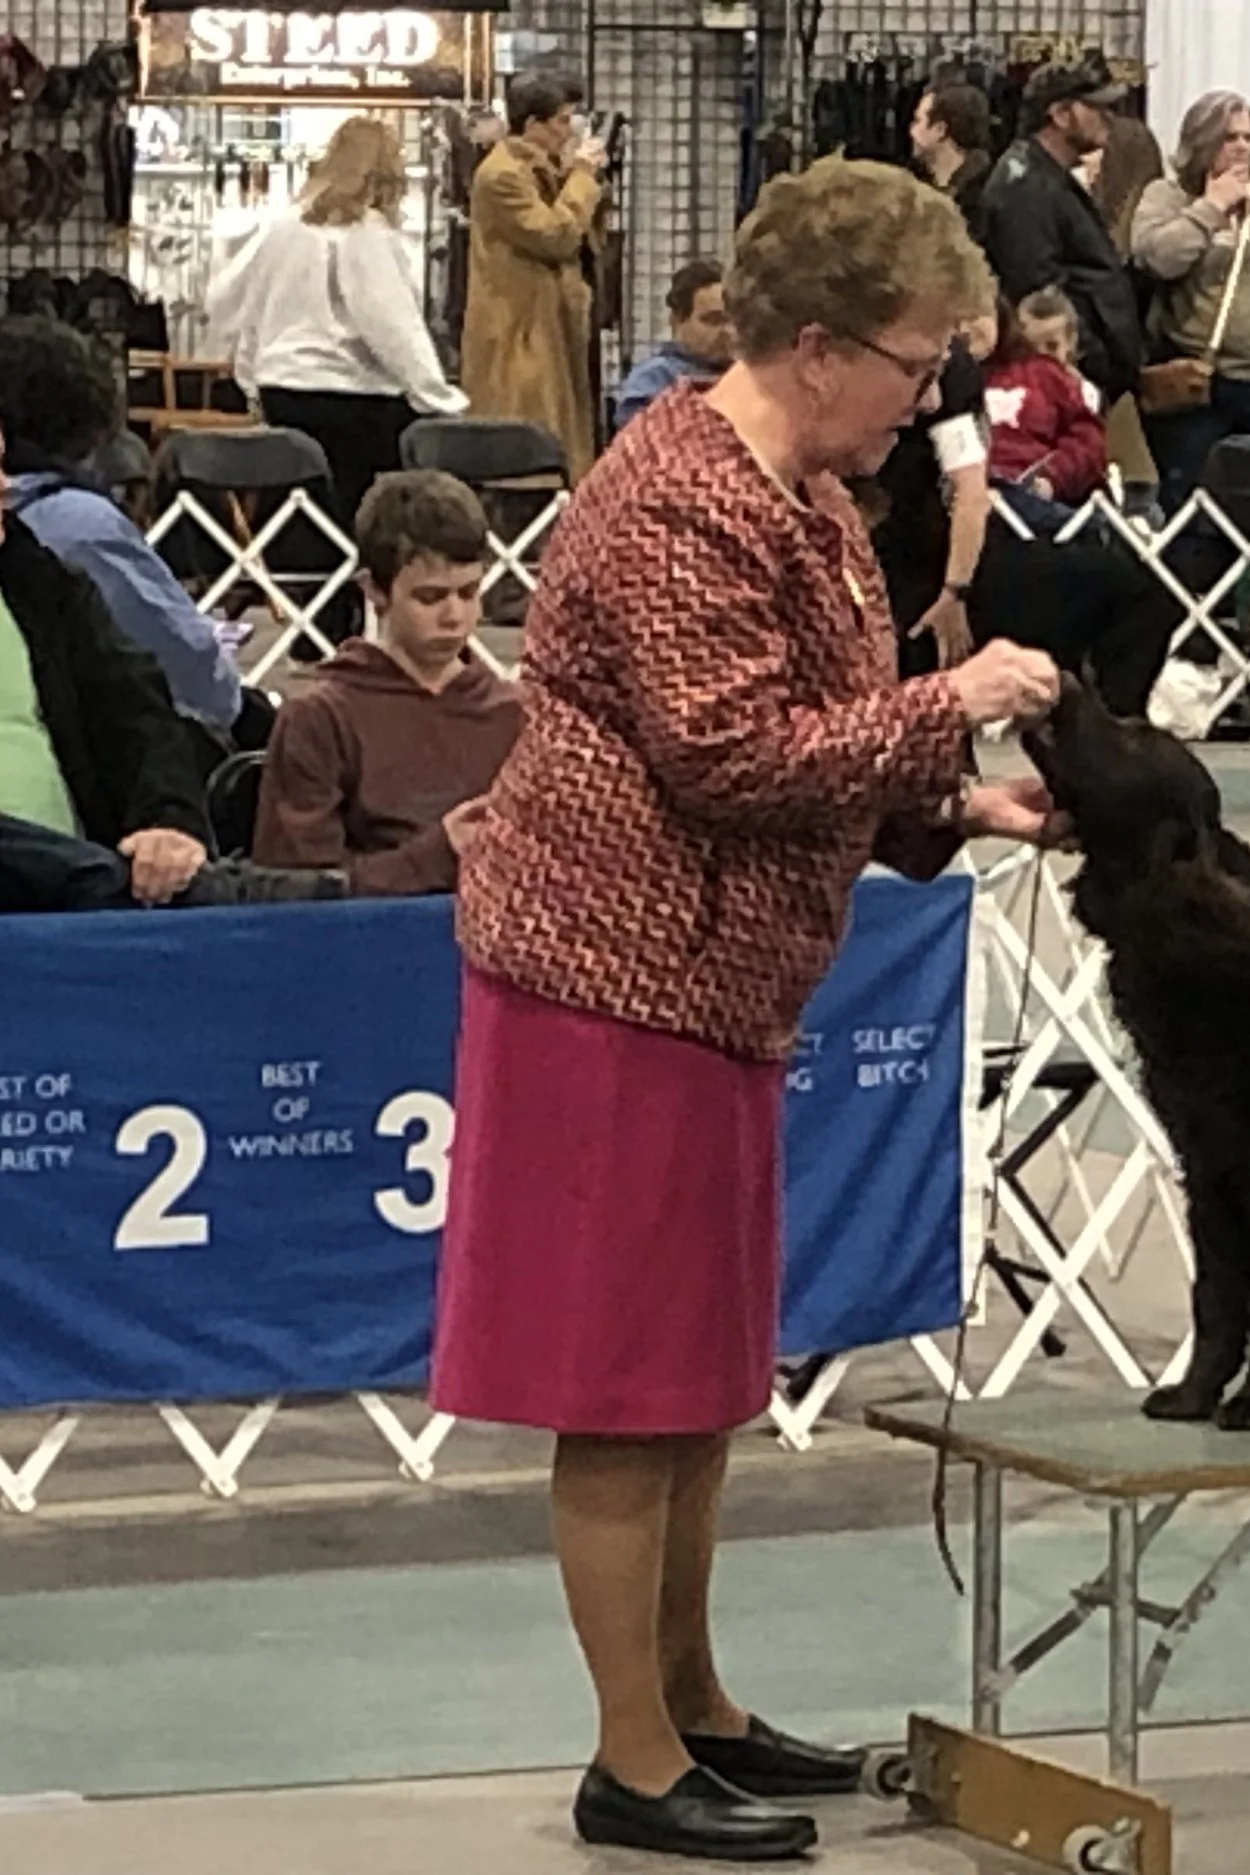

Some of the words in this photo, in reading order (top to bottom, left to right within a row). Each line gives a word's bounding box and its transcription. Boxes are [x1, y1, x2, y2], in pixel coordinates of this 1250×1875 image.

[185, 8, 440, 64] STEED
[853, 1023, 936, 1053] SELECT
[0, 1075, 28, 1100] ST
[35, 1072, 72, 1098] OF
[261, 1060, 321, 1088] BEST
[45, 1109, 87, 1134] OR
[273, 1097, 310, 1123] OF
[0, 1144, 75, 1172] RIETY
[229, 1128, 355, 1159] WINNERS
[374, 1089, 456, 1234] 3
[113, 1103, 209, 1250] 2
